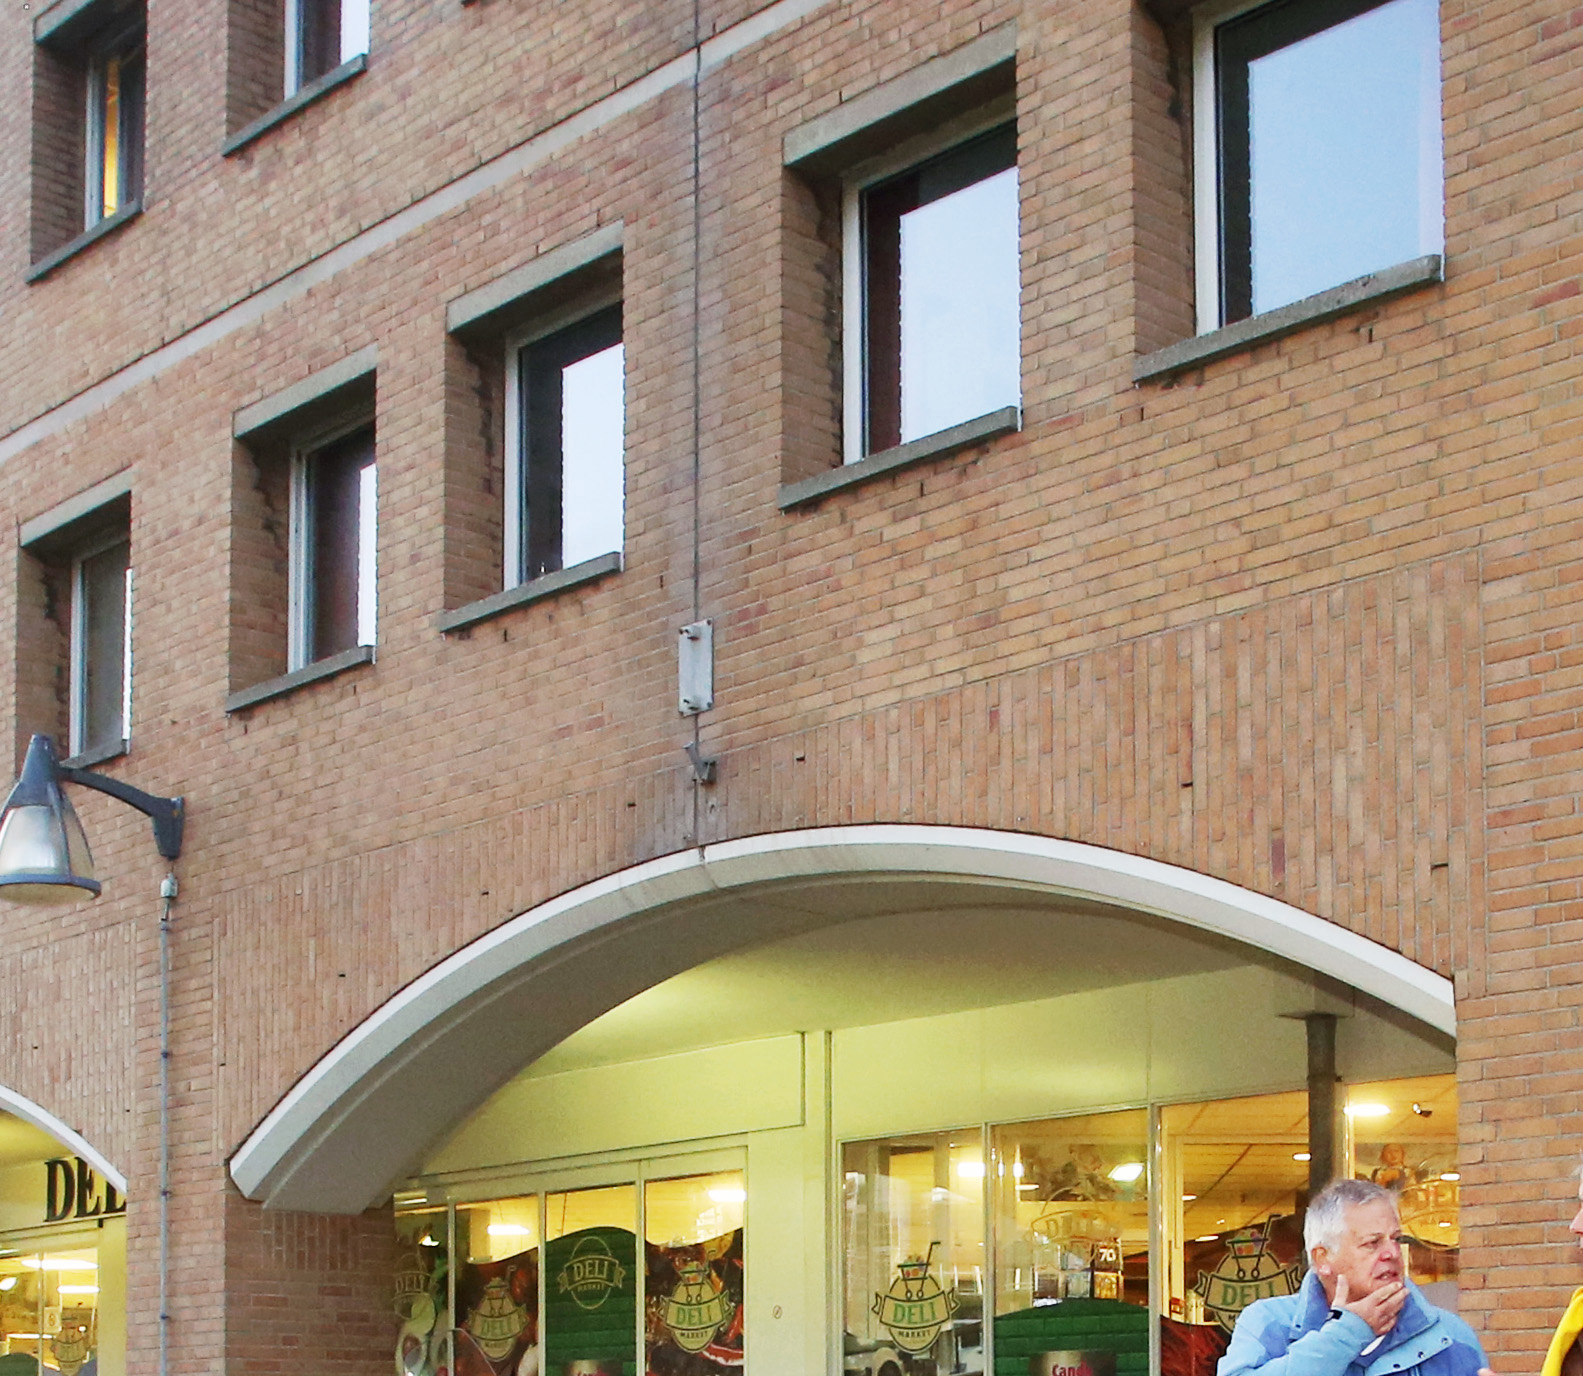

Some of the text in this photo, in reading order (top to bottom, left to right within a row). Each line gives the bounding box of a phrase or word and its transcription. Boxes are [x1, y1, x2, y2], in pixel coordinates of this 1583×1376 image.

[573, 1259, 609, 1282] DELI
[675, 1306, 713, 1327] DELI
[892, 1302, 938, 1325] DELI
[897, 1329, 932, 1339] MARKET
